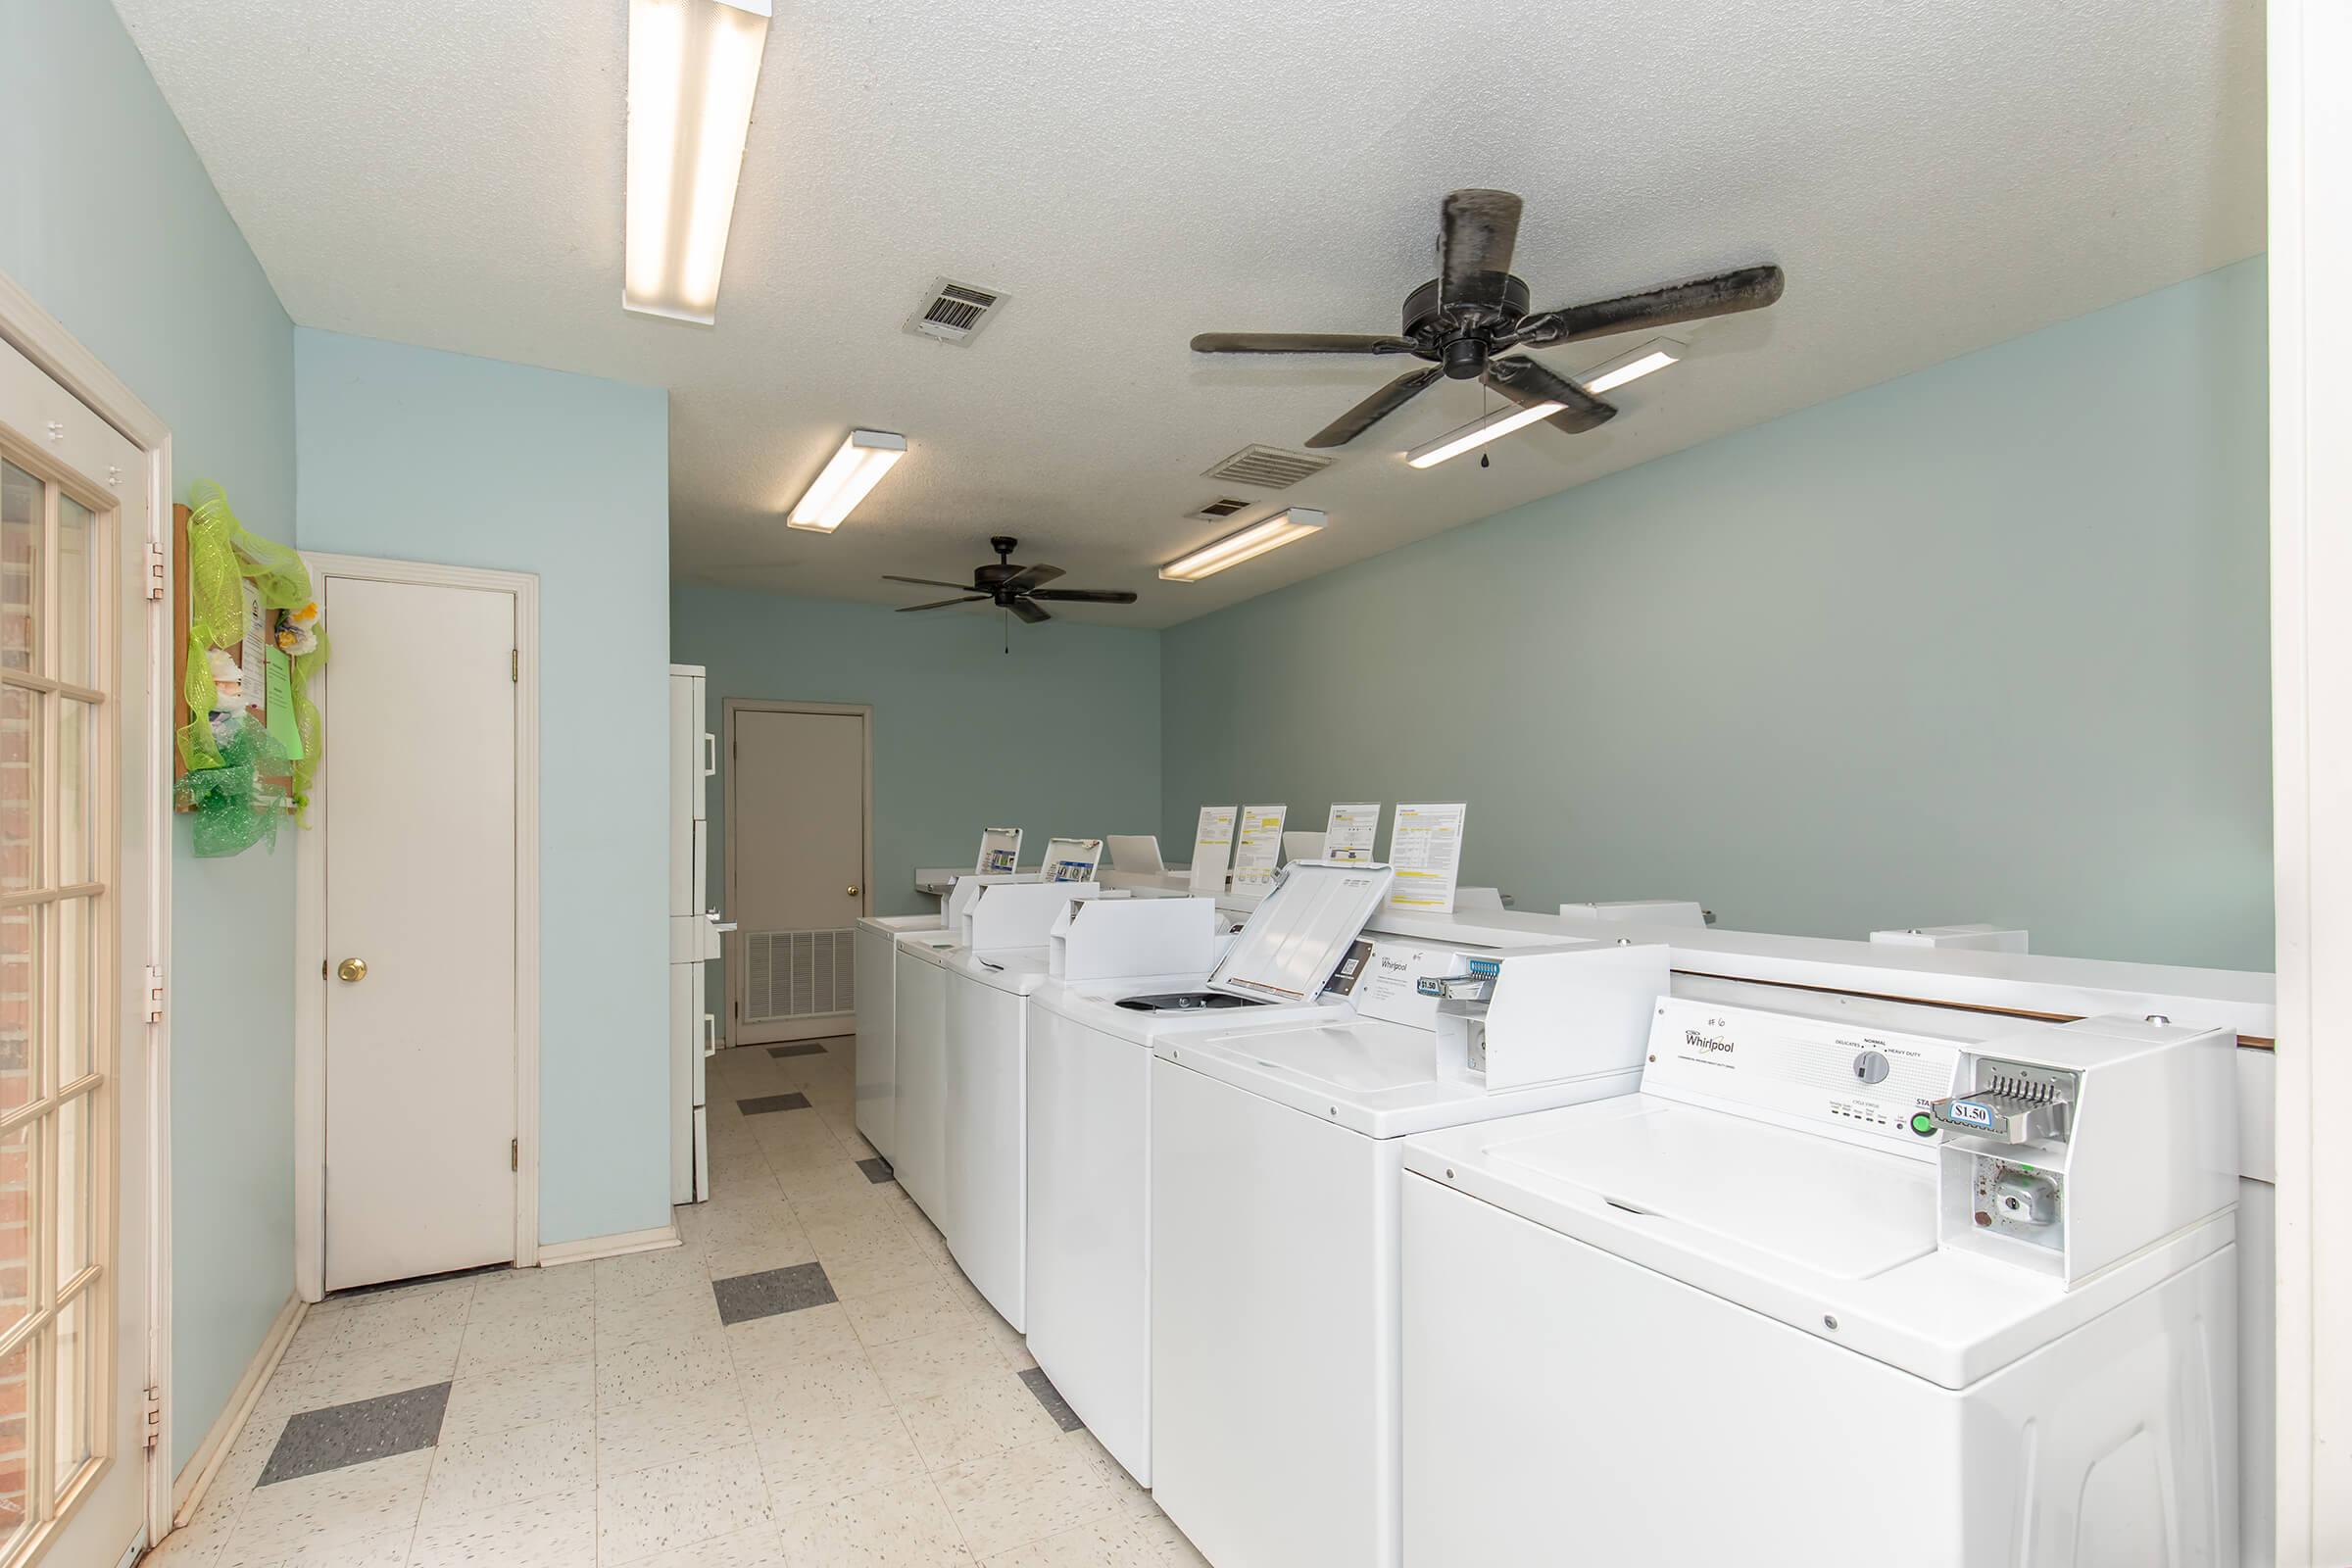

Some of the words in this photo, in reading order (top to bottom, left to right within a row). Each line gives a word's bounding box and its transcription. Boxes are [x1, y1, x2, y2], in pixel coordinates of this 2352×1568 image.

[1381, 959, 1408, 971] Whirlpool
[1421, 980, 1437, 990] $1.50
[1686, 1035, 1734, 1053] Whirlpool
[1835, 1039, 1860, 1049] DELICATES
[1864, 1038, 1886, 1047] NORMAL
[1916, 1098, 1930, 1106] STA
[1954, 1104, 1986, 1121] $1.50
